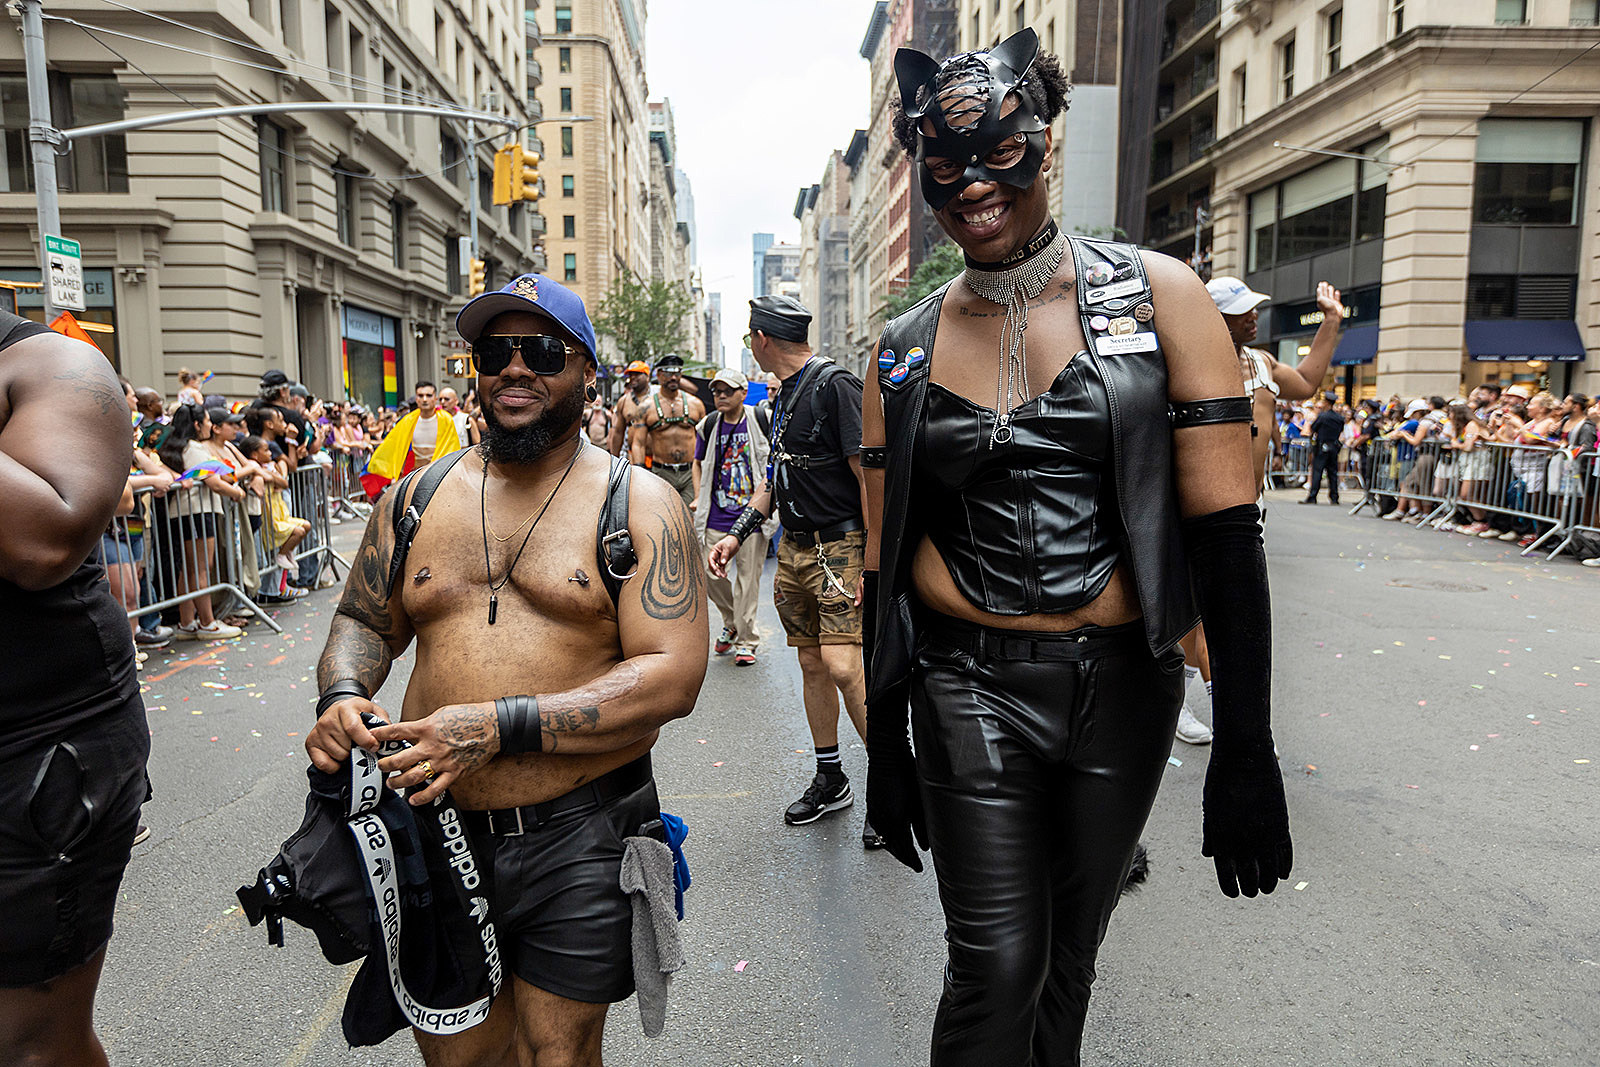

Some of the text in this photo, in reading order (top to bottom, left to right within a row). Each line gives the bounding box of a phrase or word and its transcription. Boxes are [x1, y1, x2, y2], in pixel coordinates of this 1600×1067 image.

[52, 276, 80, 291] SHARED
[83, 282, 105, 295] GE
[58, 290, 78, 303] LANE
[438, 807, 480, 890] adidas
